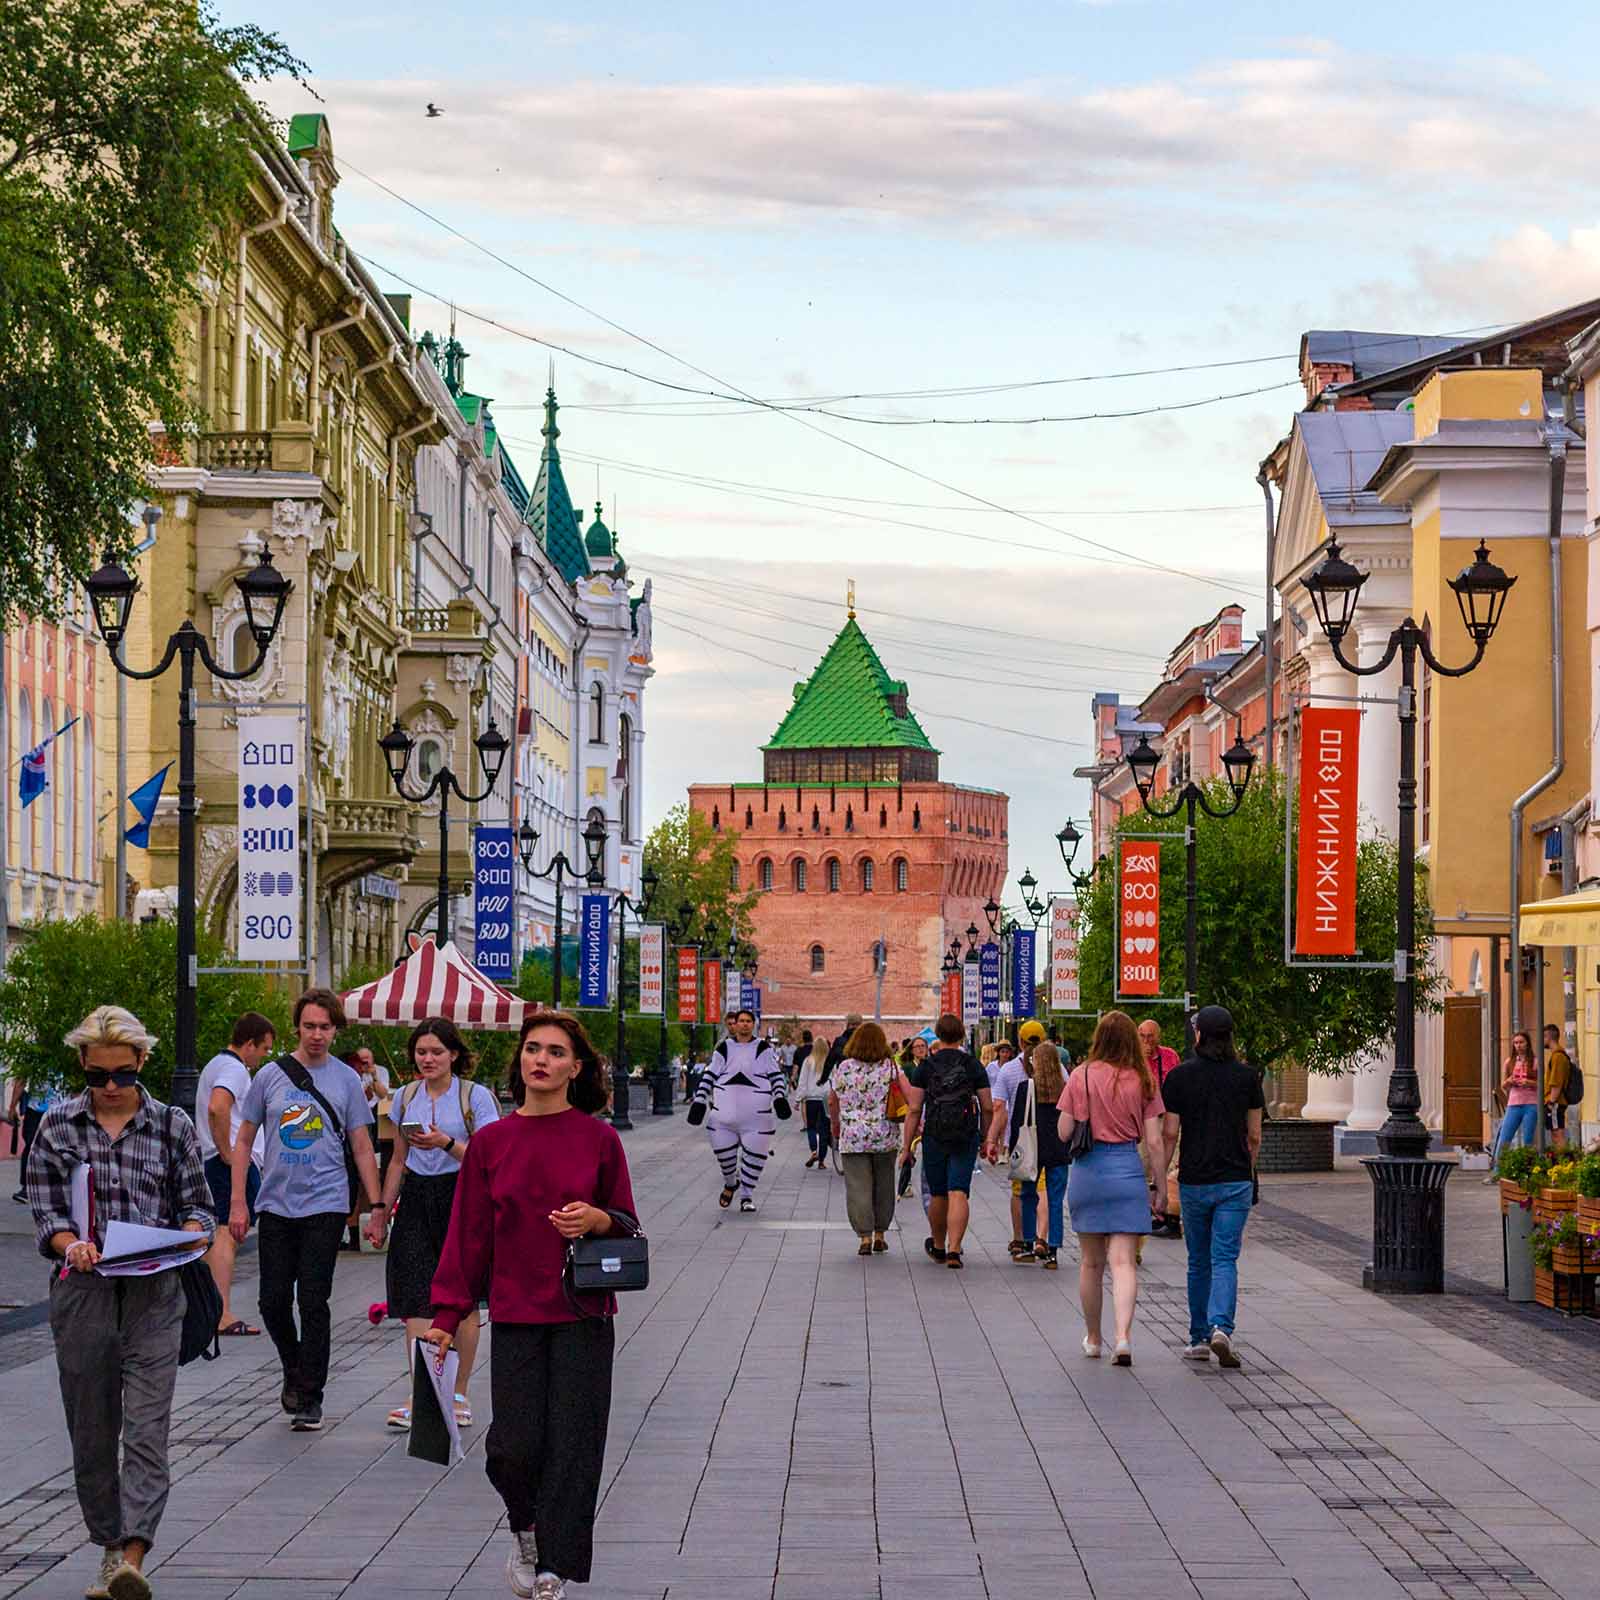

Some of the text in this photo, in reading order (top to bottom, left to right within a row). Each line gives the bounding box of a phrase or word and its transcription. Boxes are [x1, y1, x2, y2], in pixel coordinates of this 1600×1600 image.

[243, 828, 293, 852] 800
[478, 841, 509, 858] 800
[478, 868, 510, 885] 800
[1124, 883, 1157, 900] 800
[245, 915, 292, 939] 800
[1123, 965, 1156, 981] 800
